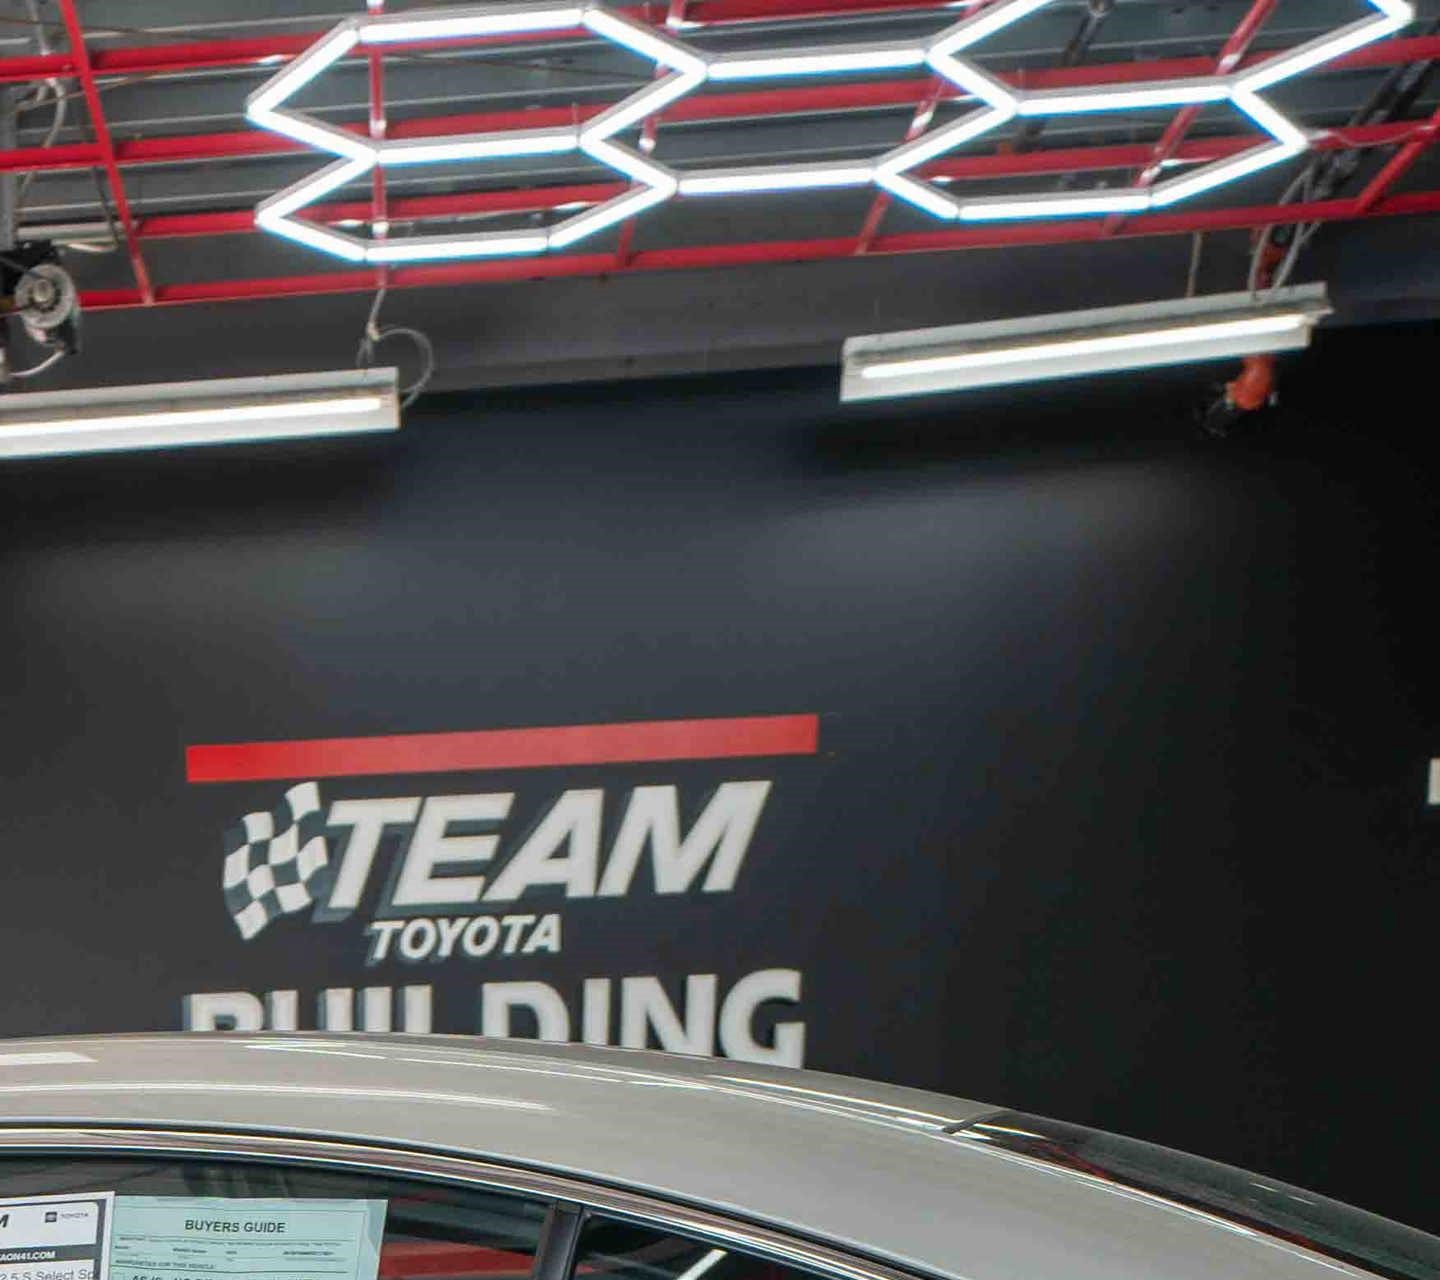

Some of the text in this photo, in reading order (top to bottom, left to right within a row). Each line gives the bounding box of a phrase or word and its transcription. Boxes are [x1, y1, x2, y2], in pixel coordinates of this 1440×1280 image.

[317, 780, 773, 915] TEAM
[366, 912, 563, 964] TOYOTA
[184, 1219, 286, 1234] BUYERS GUIDE
